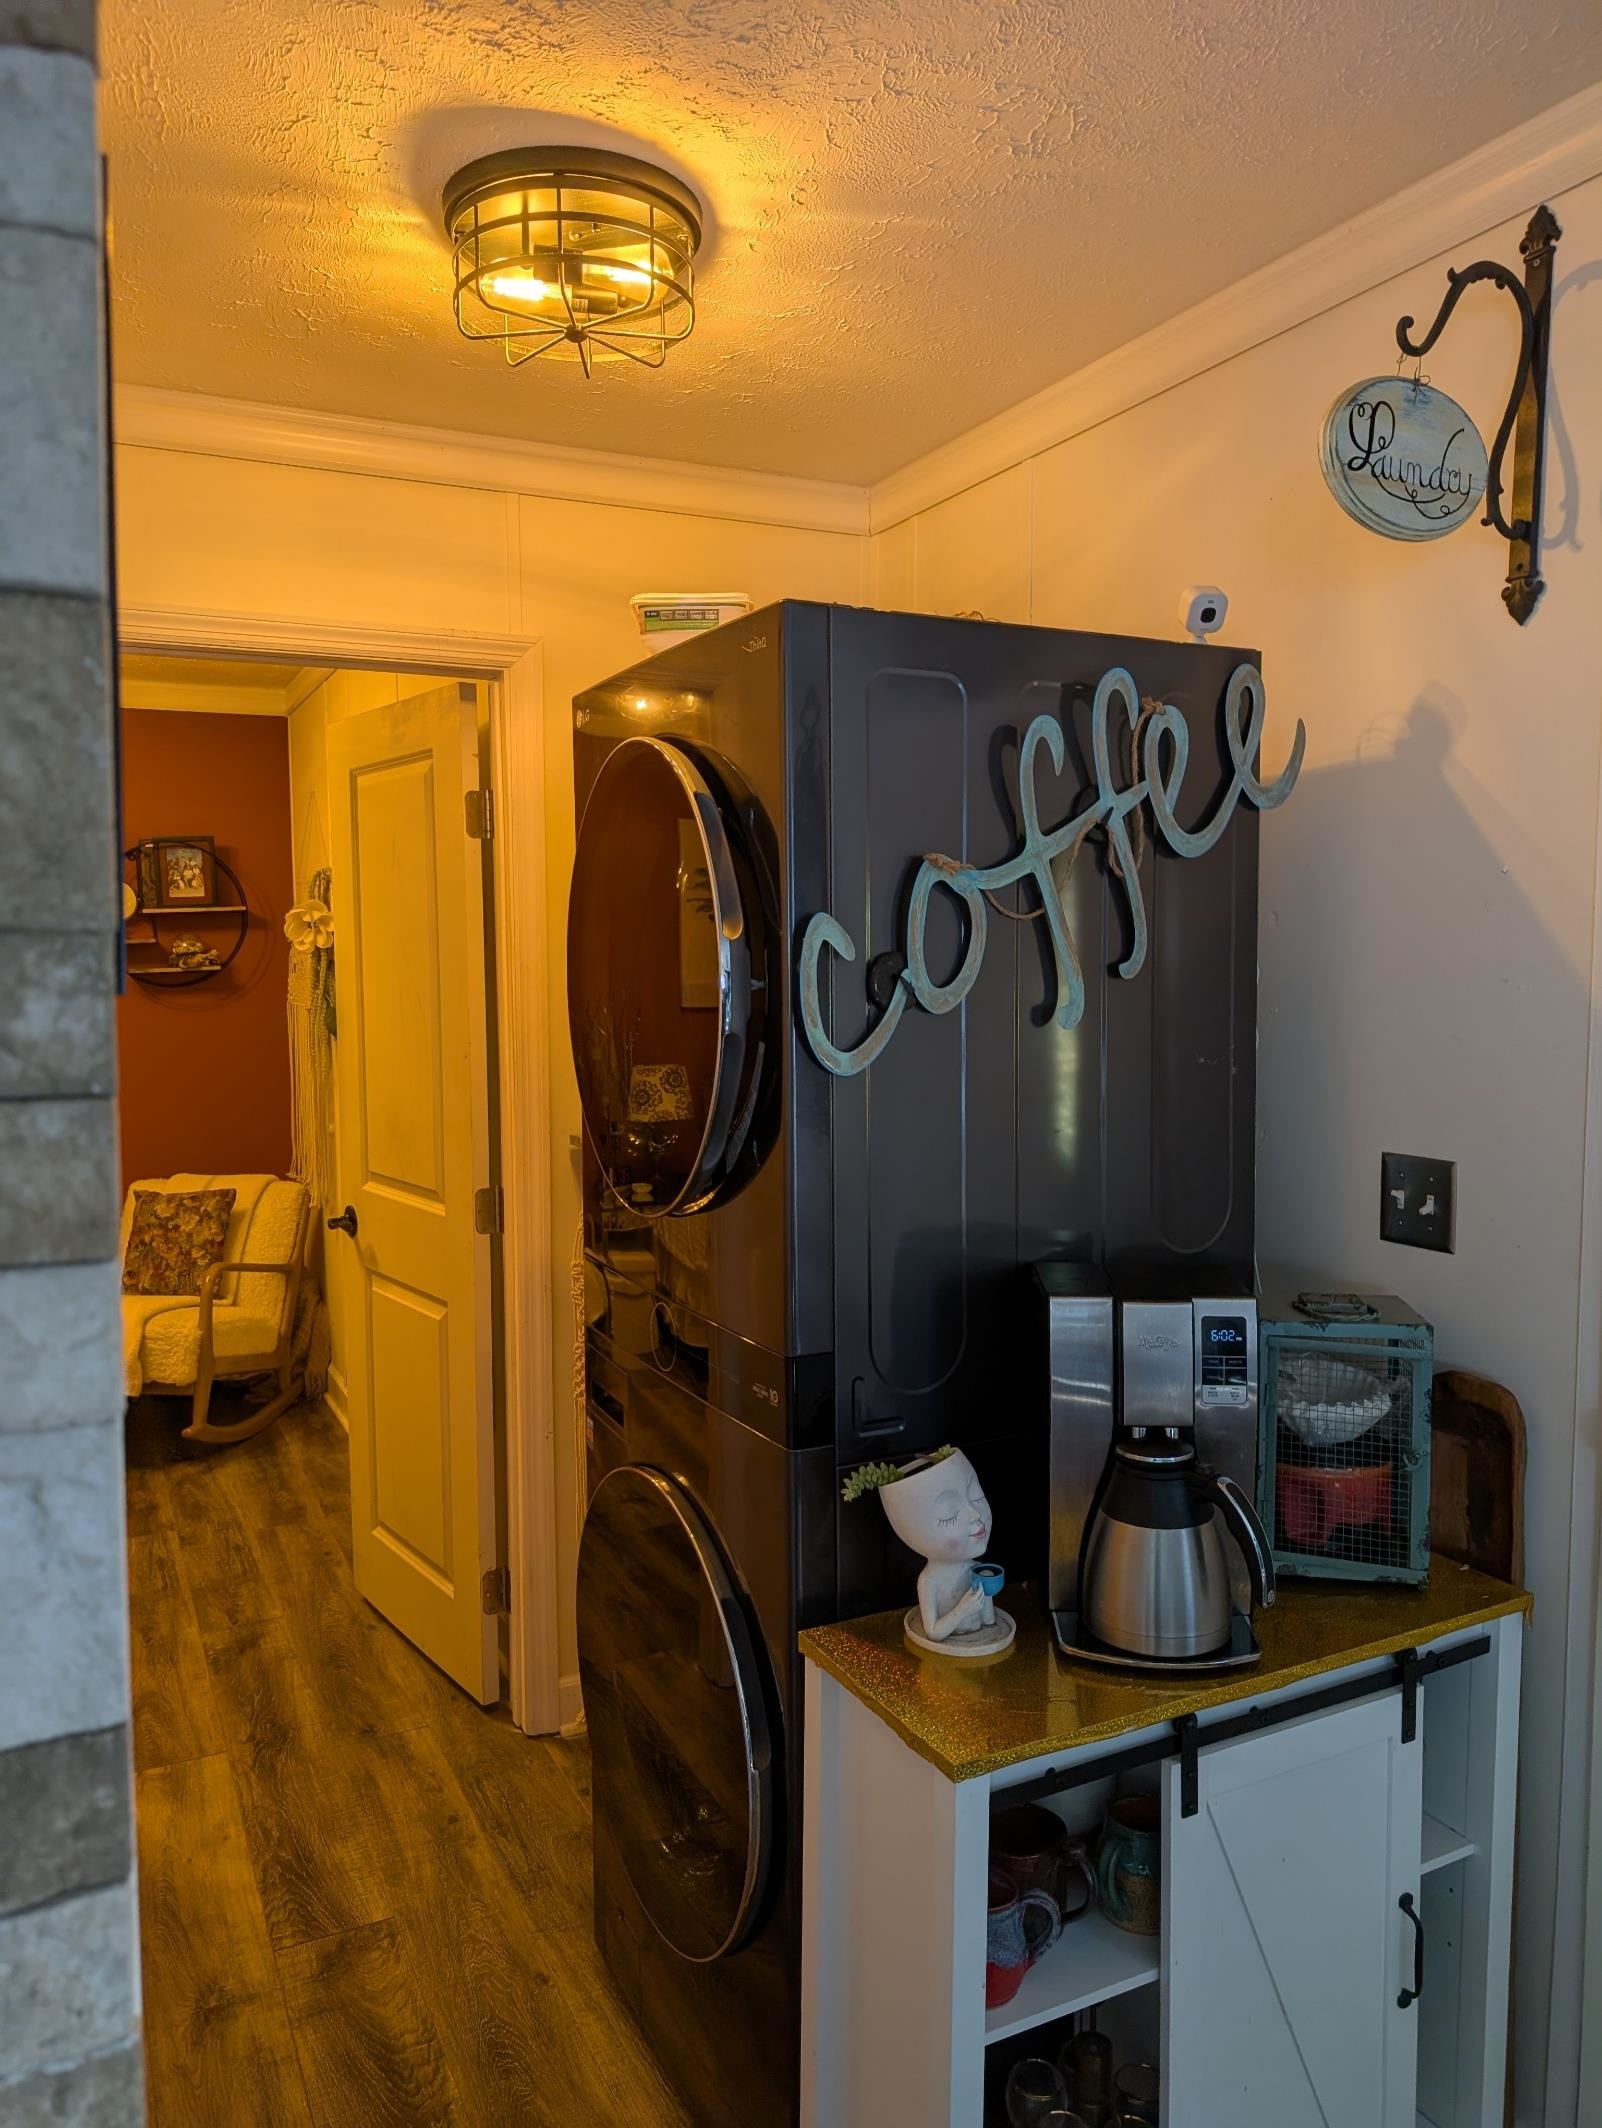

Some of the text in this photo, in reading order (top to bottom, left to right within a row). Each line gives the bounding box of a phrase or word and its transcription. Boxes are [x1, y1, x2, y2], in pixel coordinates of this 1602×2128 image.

[1347, 400, 1473, 520] Laundry
[800, 663, 1306, 1077] coffee
[1211, 1329, 1235, 1342] 6:02
